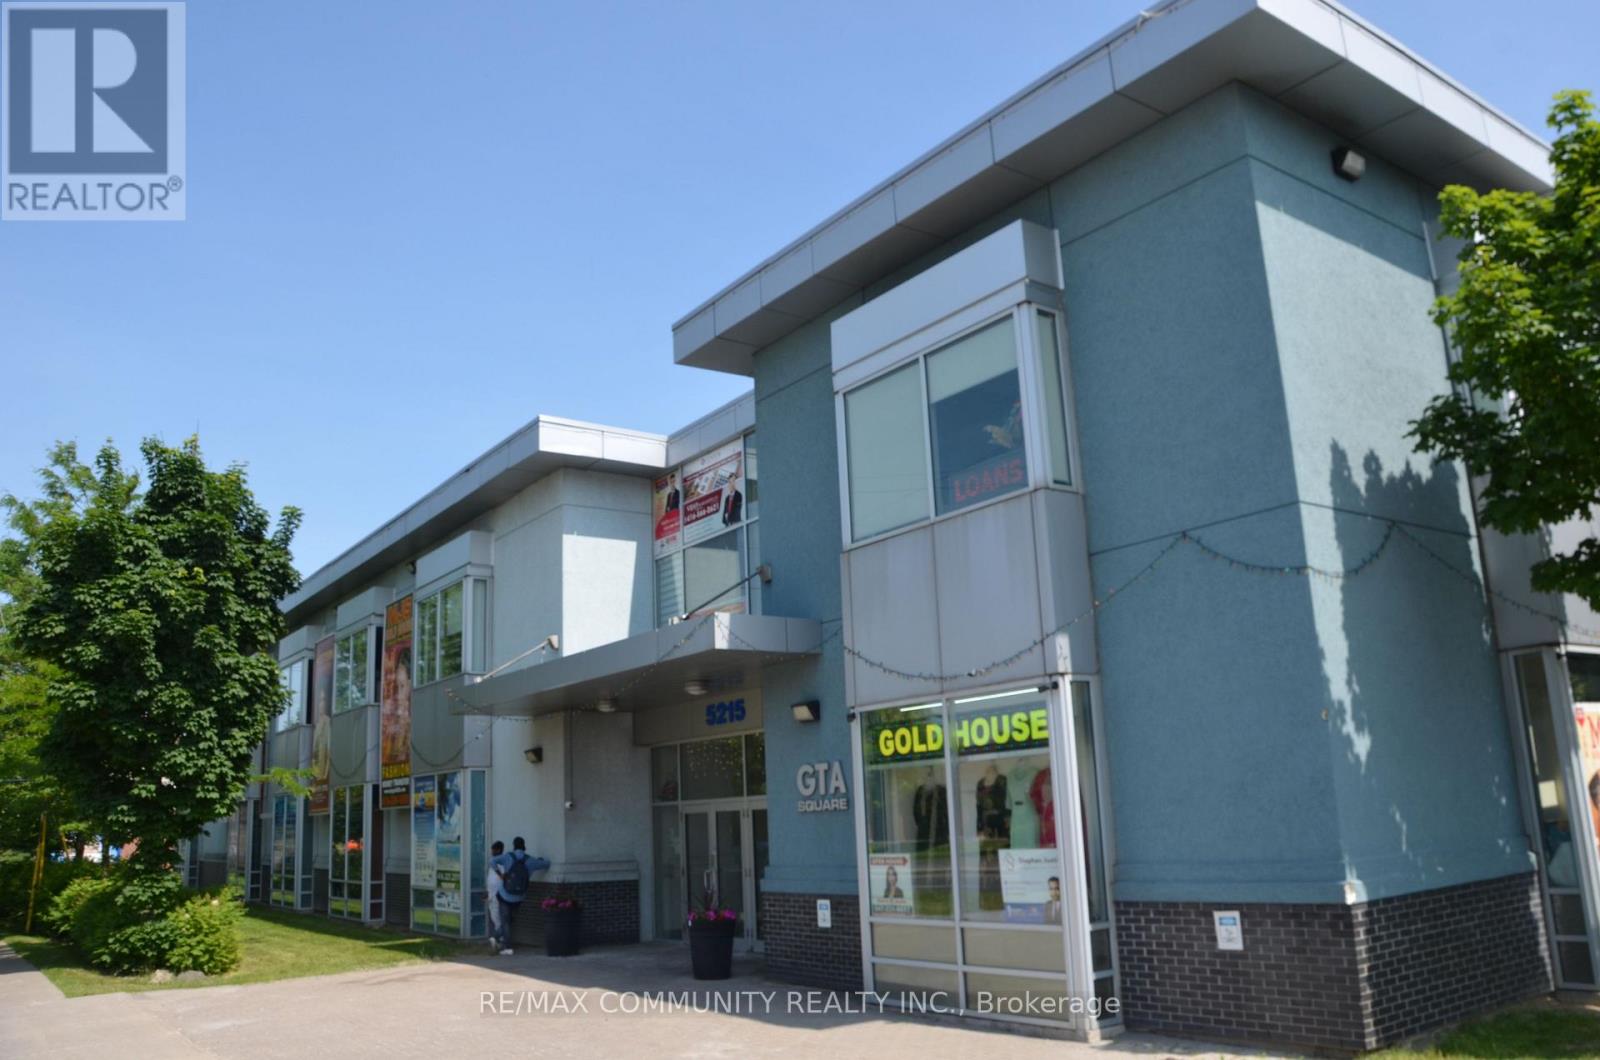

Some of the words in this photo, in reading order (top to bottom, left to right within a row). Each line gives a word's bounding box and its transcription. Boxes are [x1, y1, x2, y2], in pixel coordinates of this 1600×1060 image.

[955, 457, 1024, 502] LOANS
[705, 698, 746, 726] 5215
[879, 723, 943, 757] GOLD
[956, 709, 1049, 748] HOUSE
[796, 760, 847, 797] GTA
[798, 798, 849, 812] SQUARE
